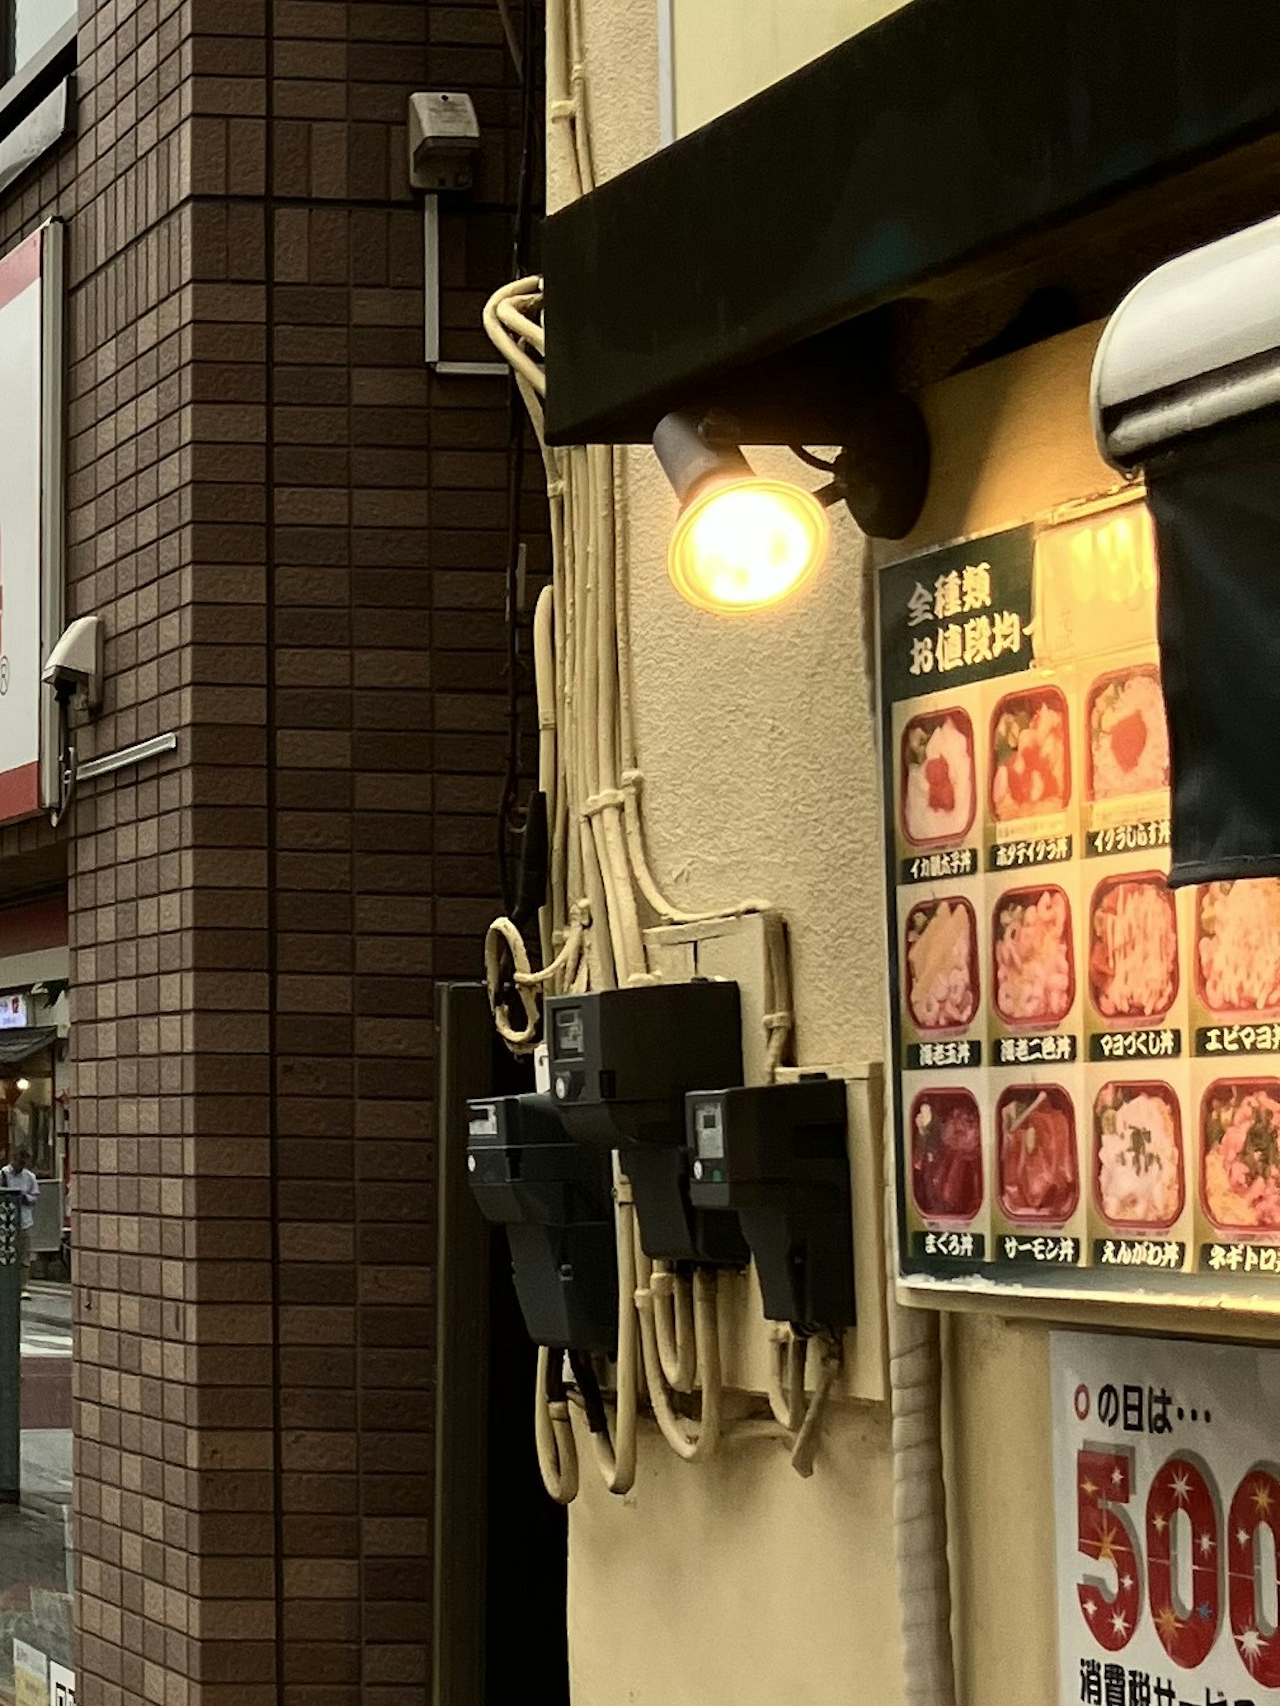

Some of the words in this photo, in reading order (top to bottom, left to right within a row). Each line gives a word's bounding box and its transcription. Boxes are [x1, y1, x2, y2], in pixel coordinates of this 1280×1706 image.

[907, 561, 991, 626] 全種類
[996, 837, 1068, 867] ホタテイクラ丼
[1004, 1236, 1075, 1262] サーモン丼
[1101, 1240, 1180, 1269] えんがわ丼
